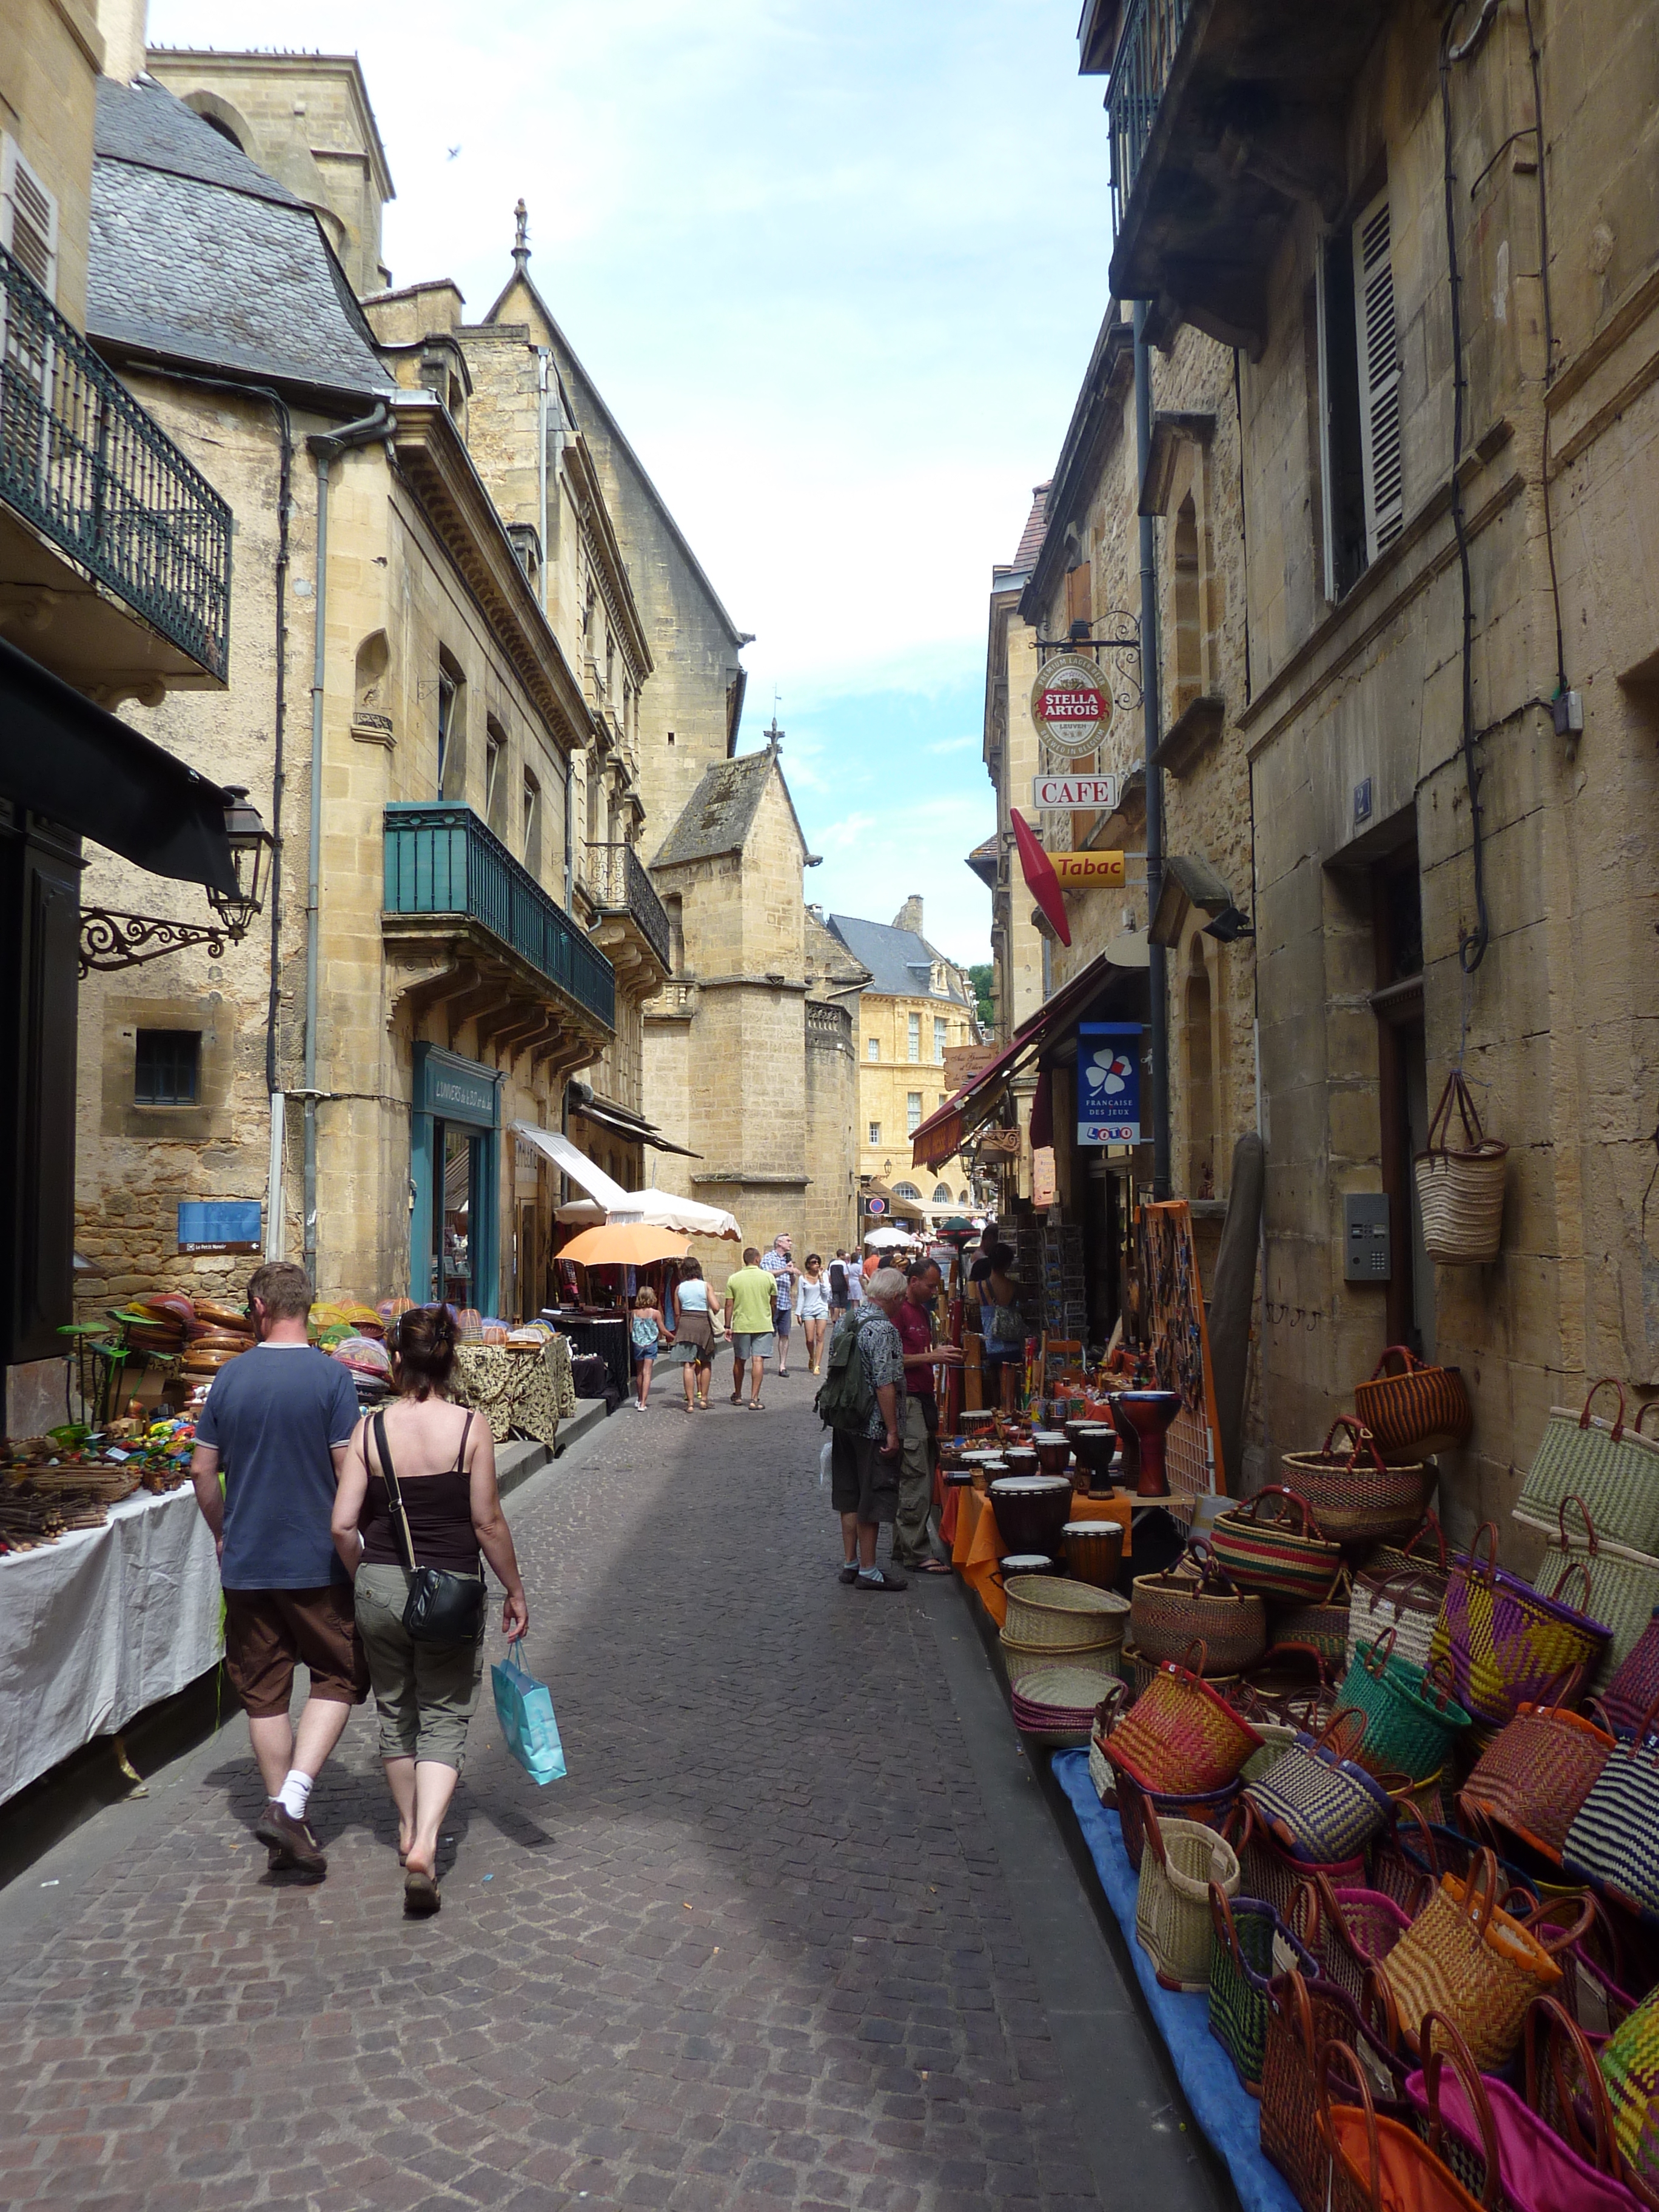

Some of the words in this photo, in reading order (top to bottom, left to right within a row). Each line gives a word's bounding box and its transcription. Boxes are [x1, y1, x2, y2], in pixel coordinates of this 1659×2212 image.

[1038, 659, 1066, 685] PREMIUM
[1069, 657, 1091, 669] LAGER
[1091, 668, 1105, 685] BEER
[1045, 694, 1098, 705] STELLA
[1045, 705, 1099, 716] ARTOIS
[1041, 729, 1065, 753] BREWED
[1078, 729, 1105, 754] BELGIUM
[1041, 781, 1108, 803] CAFE
[1356, 788, 1364, 815] 2
[1058, 858, 1121, 876] Tabac
[1087, 1126, 1133, 1141] LOTO
